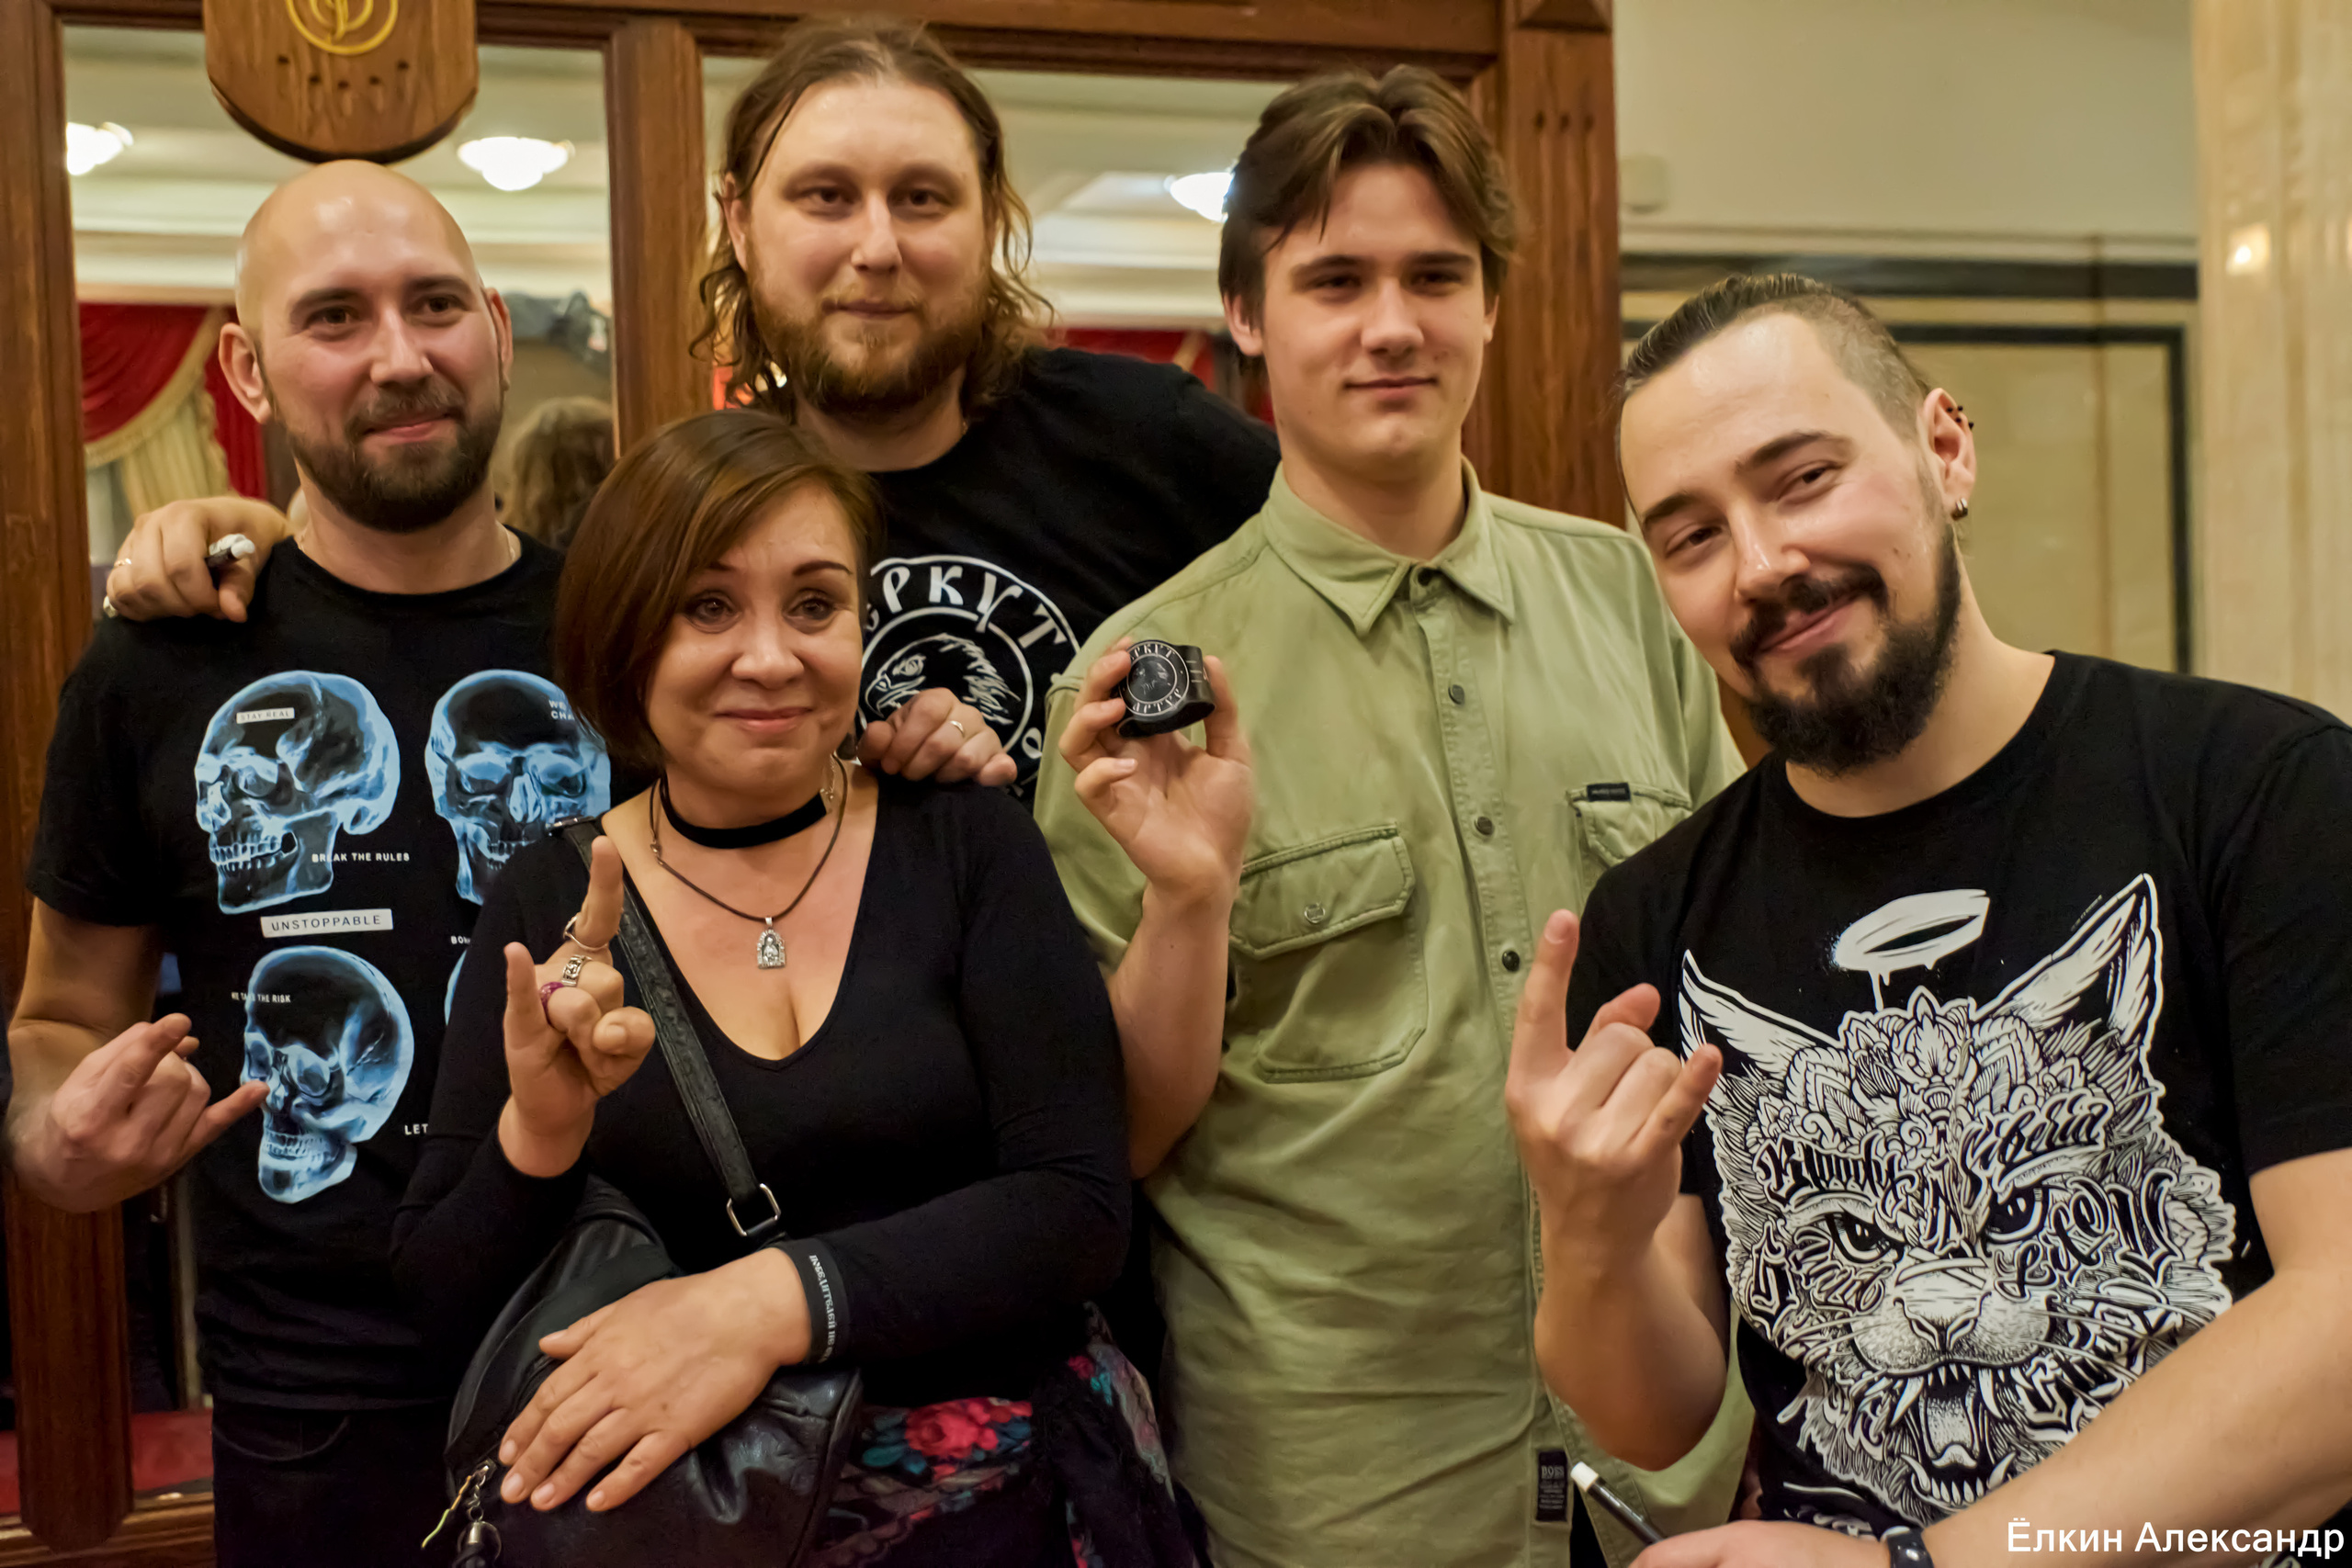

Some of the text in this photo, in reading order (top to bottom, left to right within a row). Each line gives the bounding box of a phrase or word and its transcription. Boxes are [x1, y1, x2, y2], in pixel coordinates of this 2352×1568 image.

[865, 565, 1069, 650] РКУТ
[311, 852, 410, 863] BREAK THE RULES
[271, 914, 381, 931] UNSTOPPABLE
[257, 994, 270, 1003] THE
[272, 994, 291, 1003] RISK
[404, 1123, 429, 1135] LET
